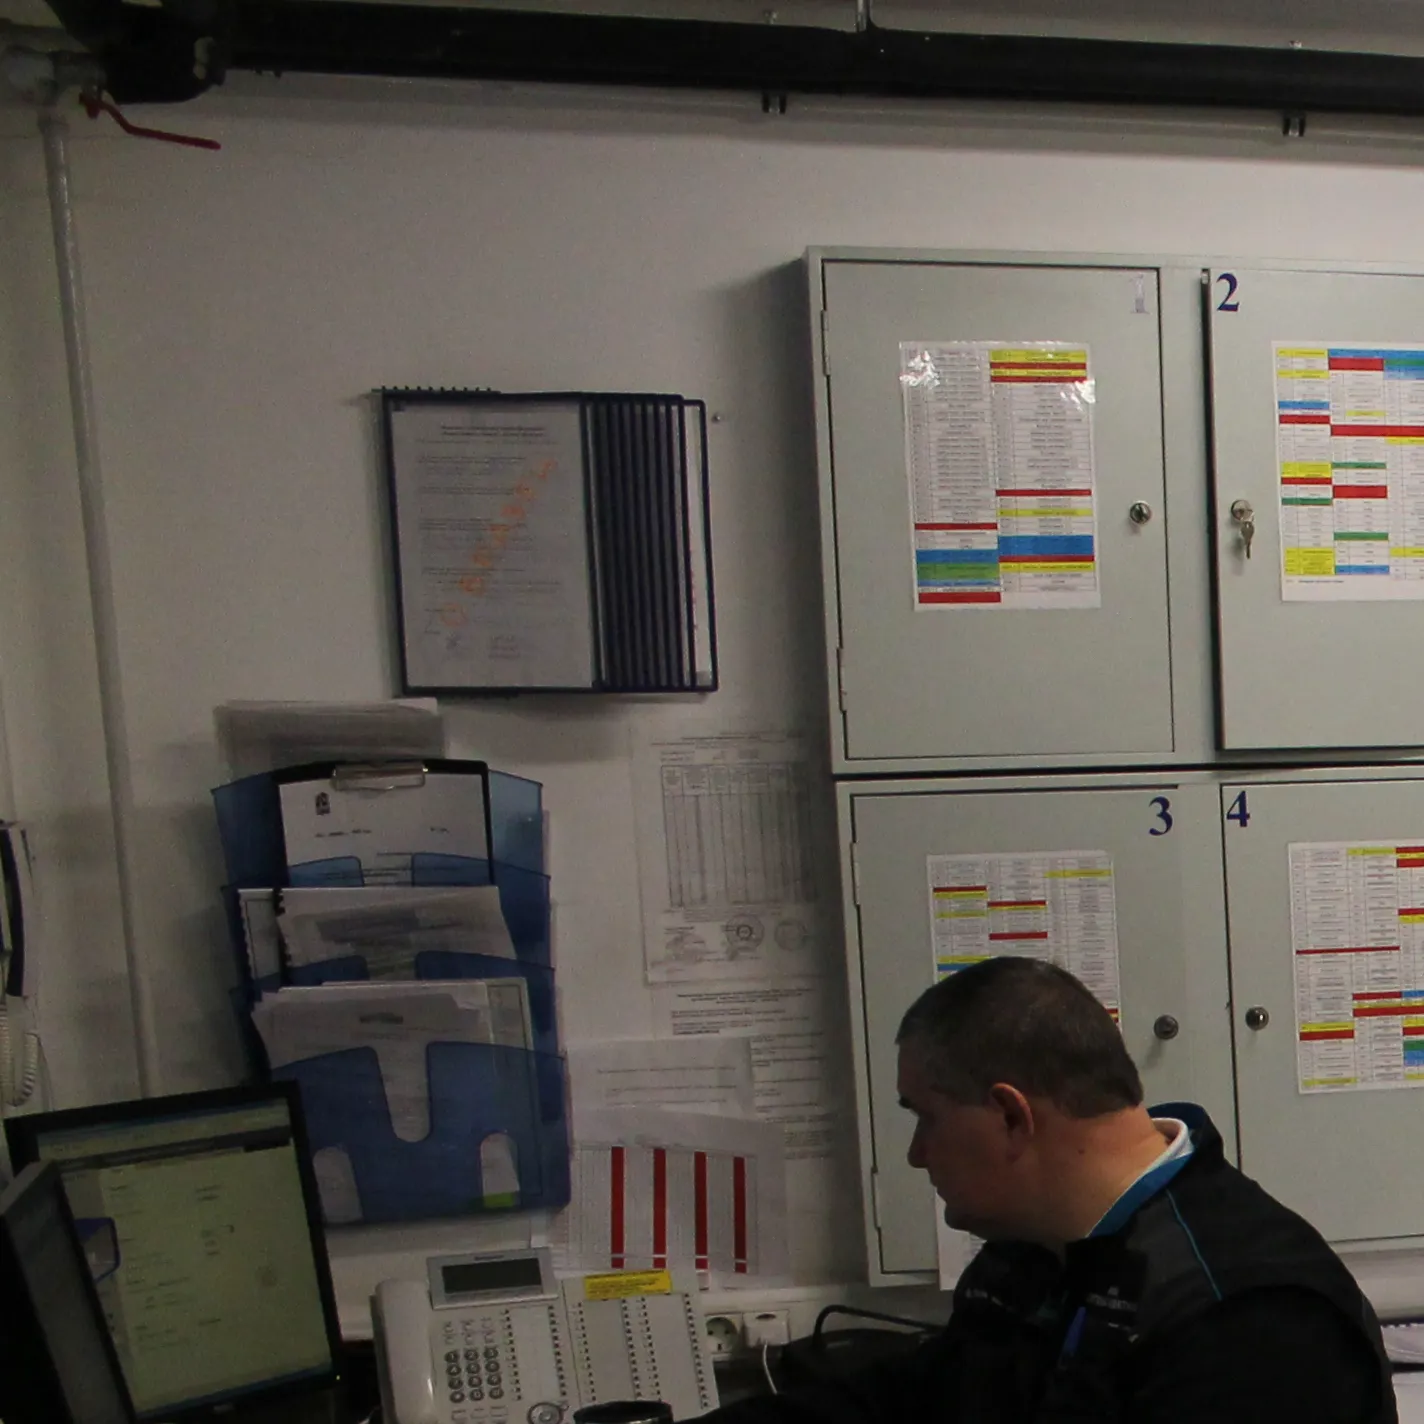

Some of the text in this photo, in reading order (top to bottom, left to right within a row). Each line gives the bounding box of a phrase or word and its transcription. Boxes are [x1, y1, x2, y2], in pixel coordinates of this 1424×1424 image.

[1129, 273, 1150, 315] 1
[1215, 271, 1241, 313] 2
[1148, 795, 1174, 836] 3
[1225, 789, 1252, 829] 4
